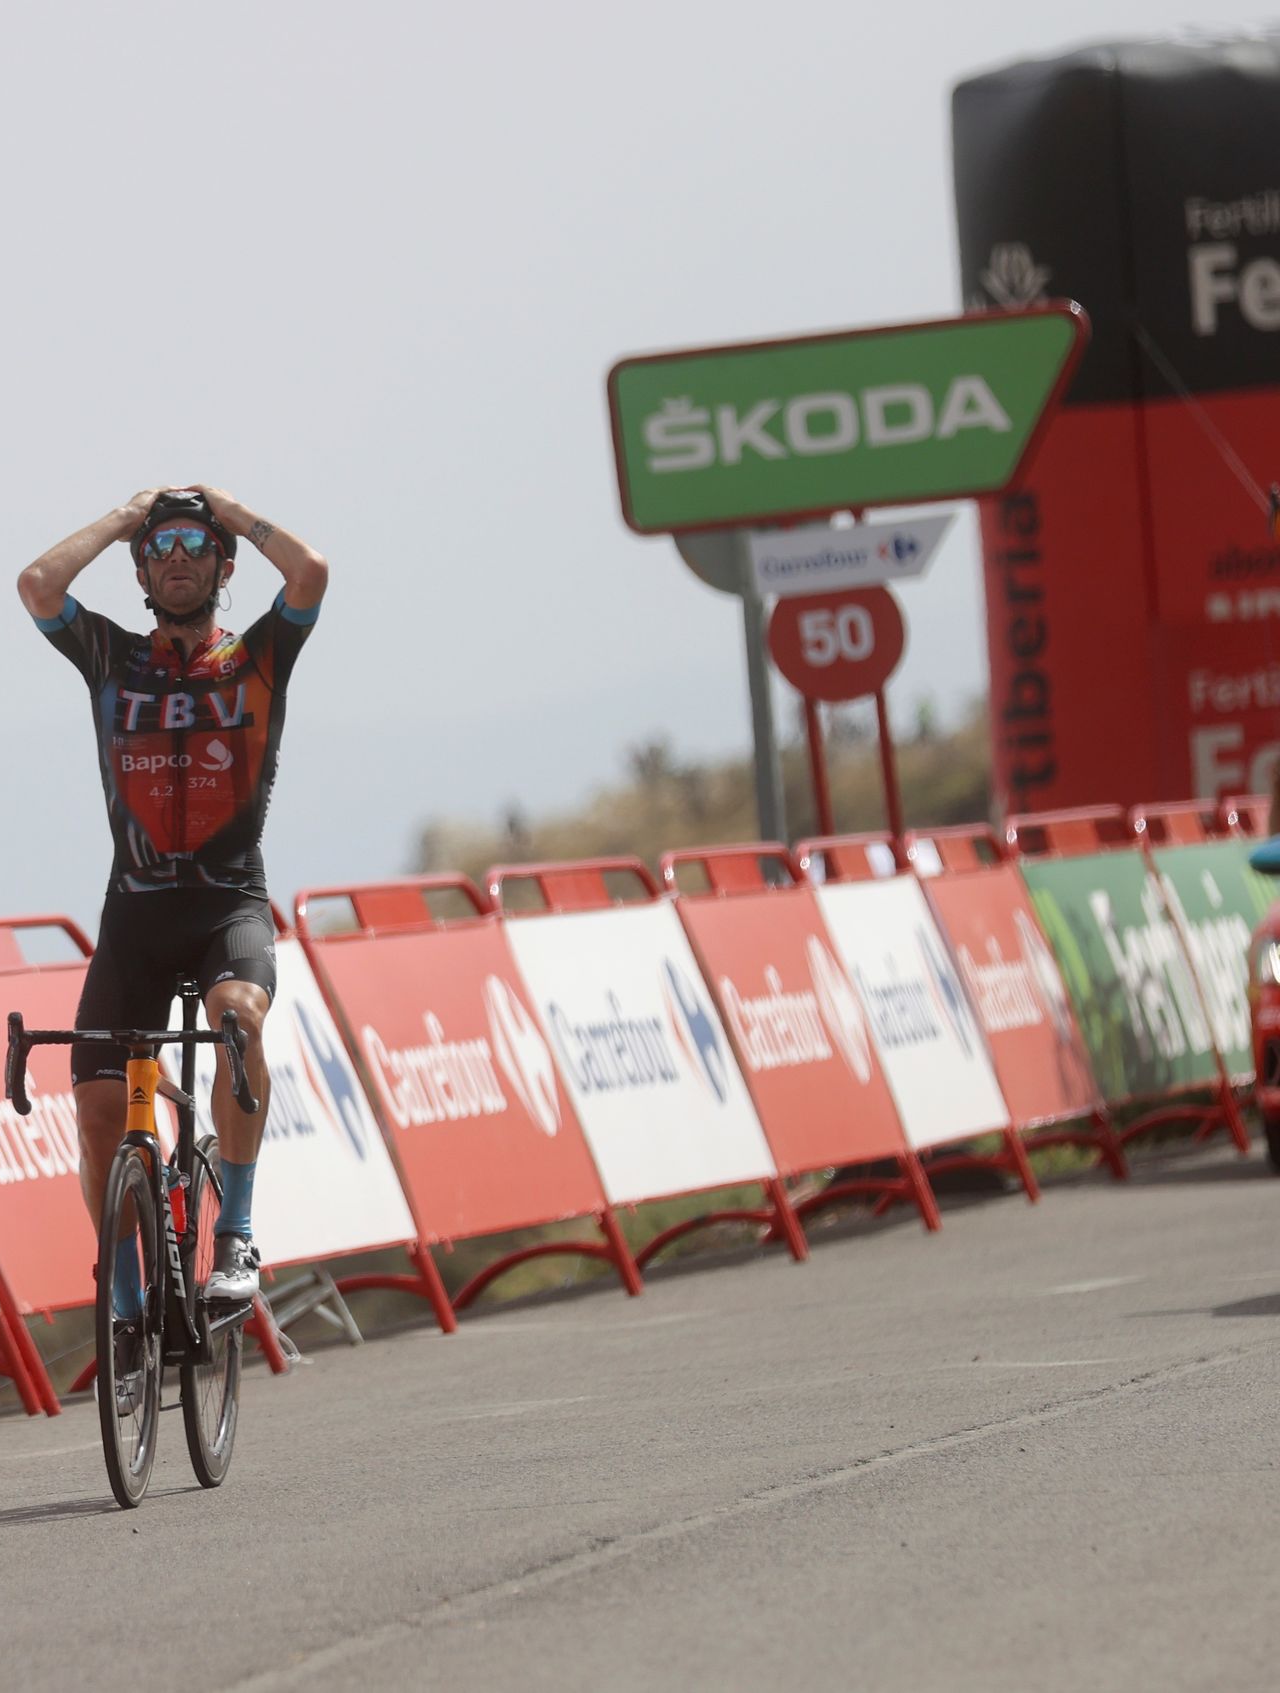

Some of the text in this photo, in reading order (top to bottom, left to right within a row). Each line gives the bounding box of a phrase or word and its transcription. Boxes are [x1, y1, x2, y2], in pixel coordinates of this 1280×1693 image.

[643, 373, 1012, 474] ŠKODA
[797, 604, 876, 668] 50
[996, 490, 1058, 792] tiberia
[119, 684, 246, 731] TBV
[121, 751, 192, 774] Bapco
[149, 785, 174, 797] 4.2
[187, 777, 218, 789] 374
[547, 988, 680, 1095] Carrefour
[721, 963, 834, 1072] Carrefour
[362, 1009, 508, 1129] Carrefour
